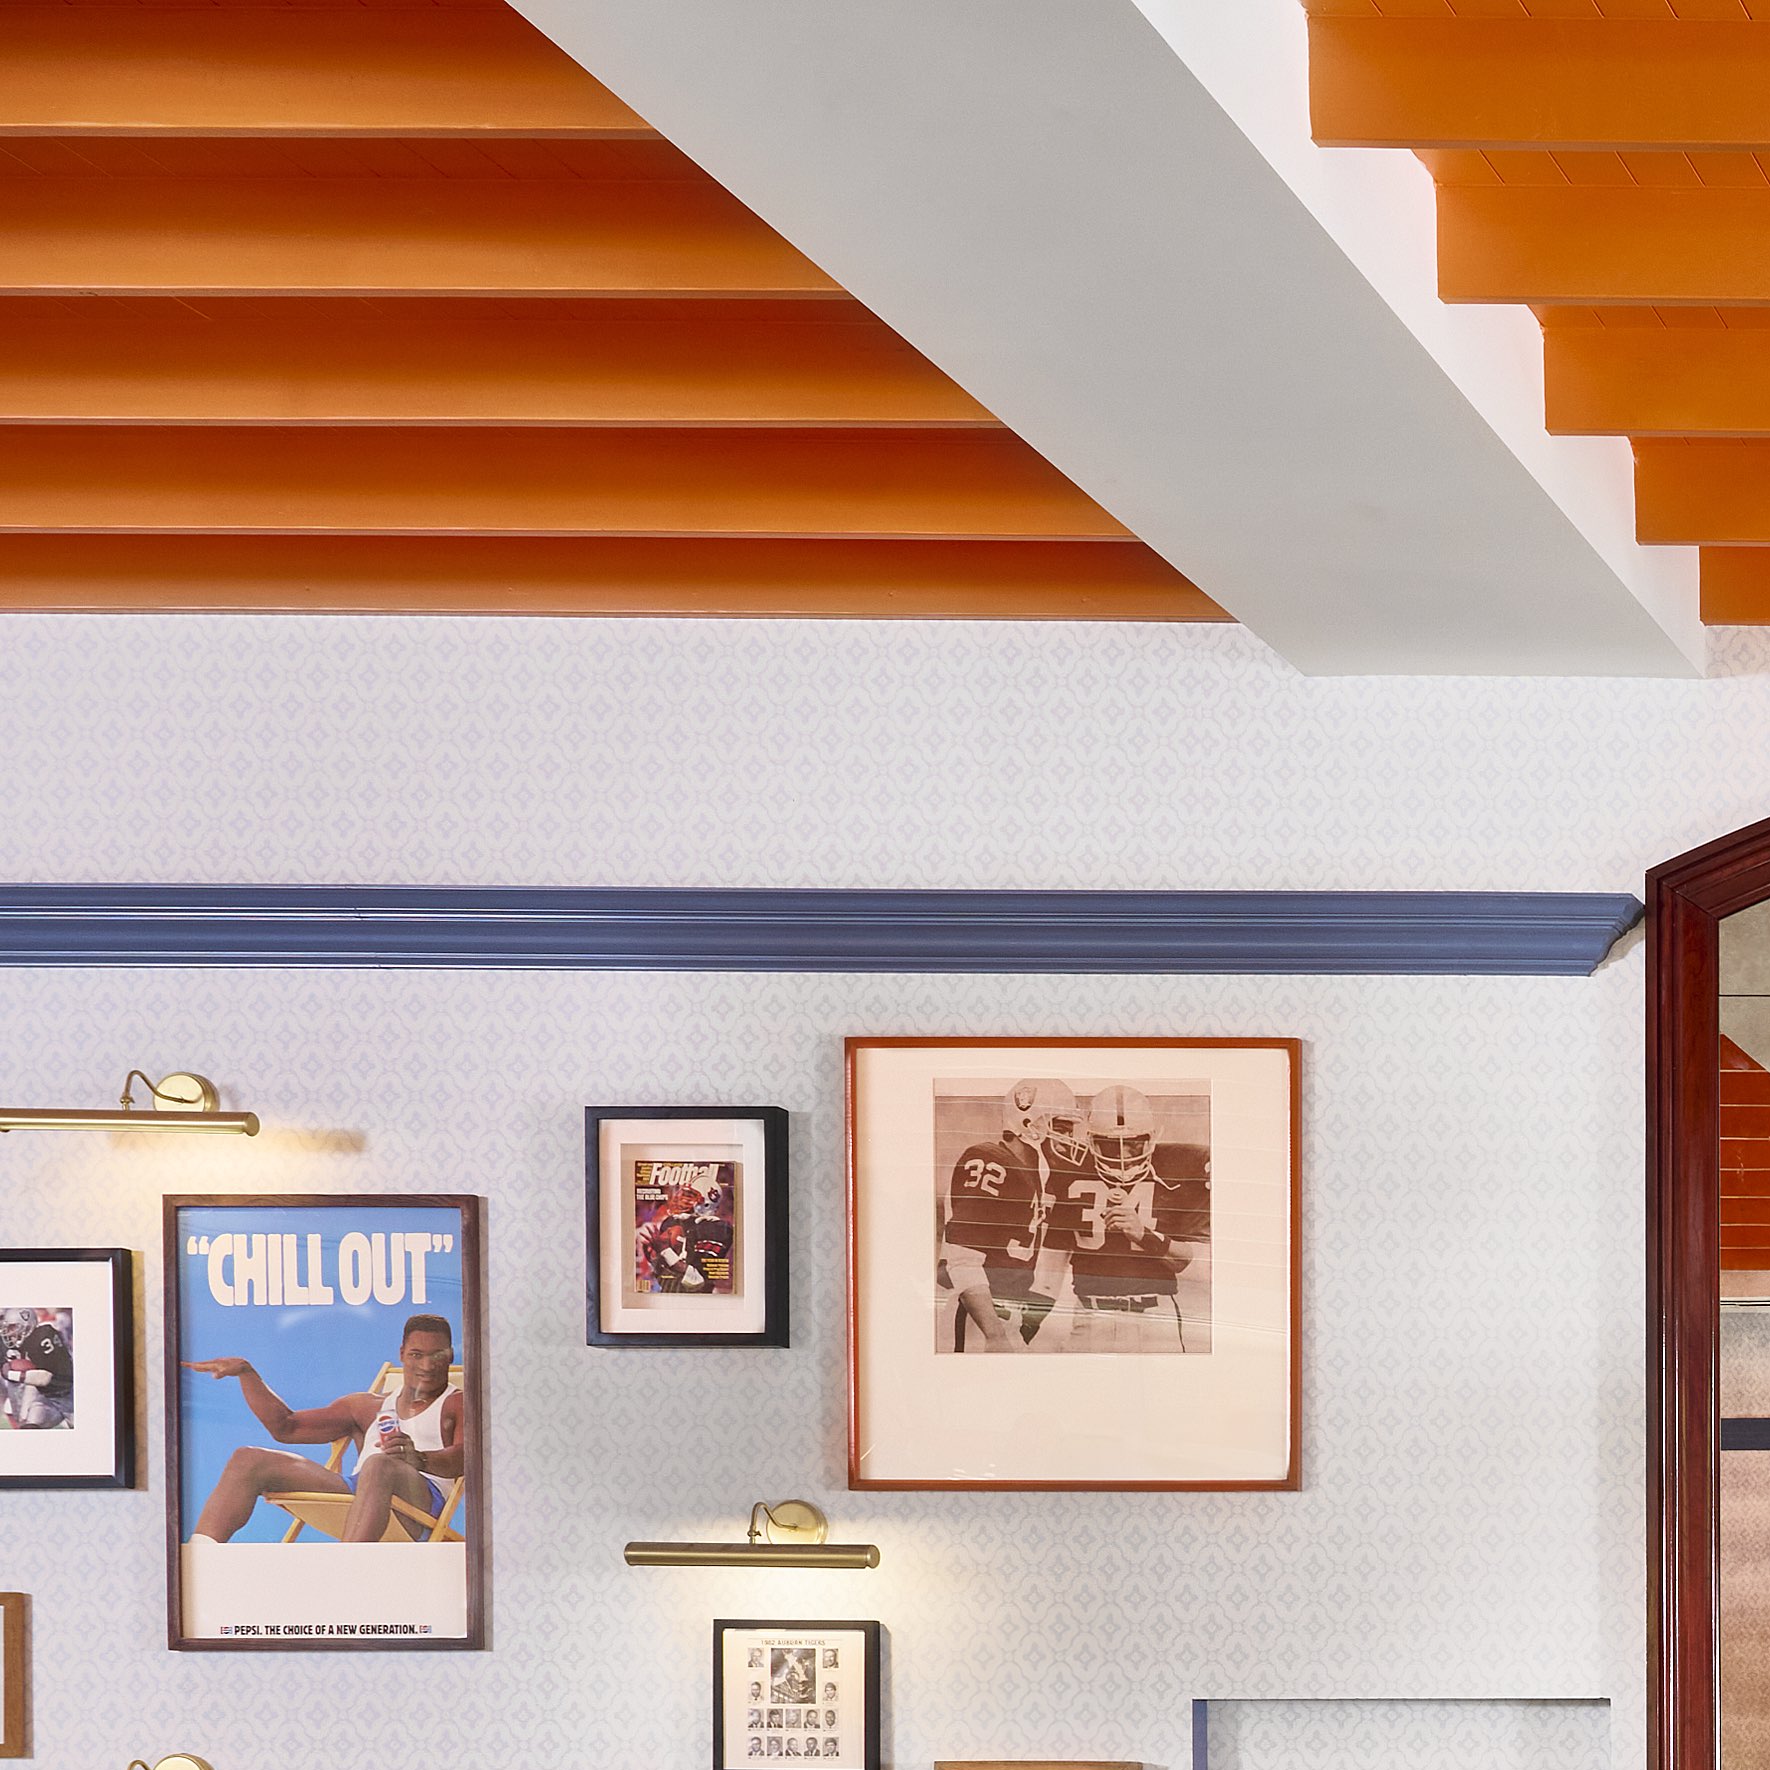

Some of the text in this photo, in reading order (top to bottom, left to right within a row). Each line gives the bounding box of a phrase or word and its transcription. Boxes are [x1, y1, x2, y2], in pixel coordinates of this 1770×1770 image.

[963, 1157, 1007, 1197] 32
[187, 1232, 453, 1307] “CHILL OUT”
[234, 1624, 418, 1635] PEPSI. THE CHOICE OF A NEW GENERATION.
